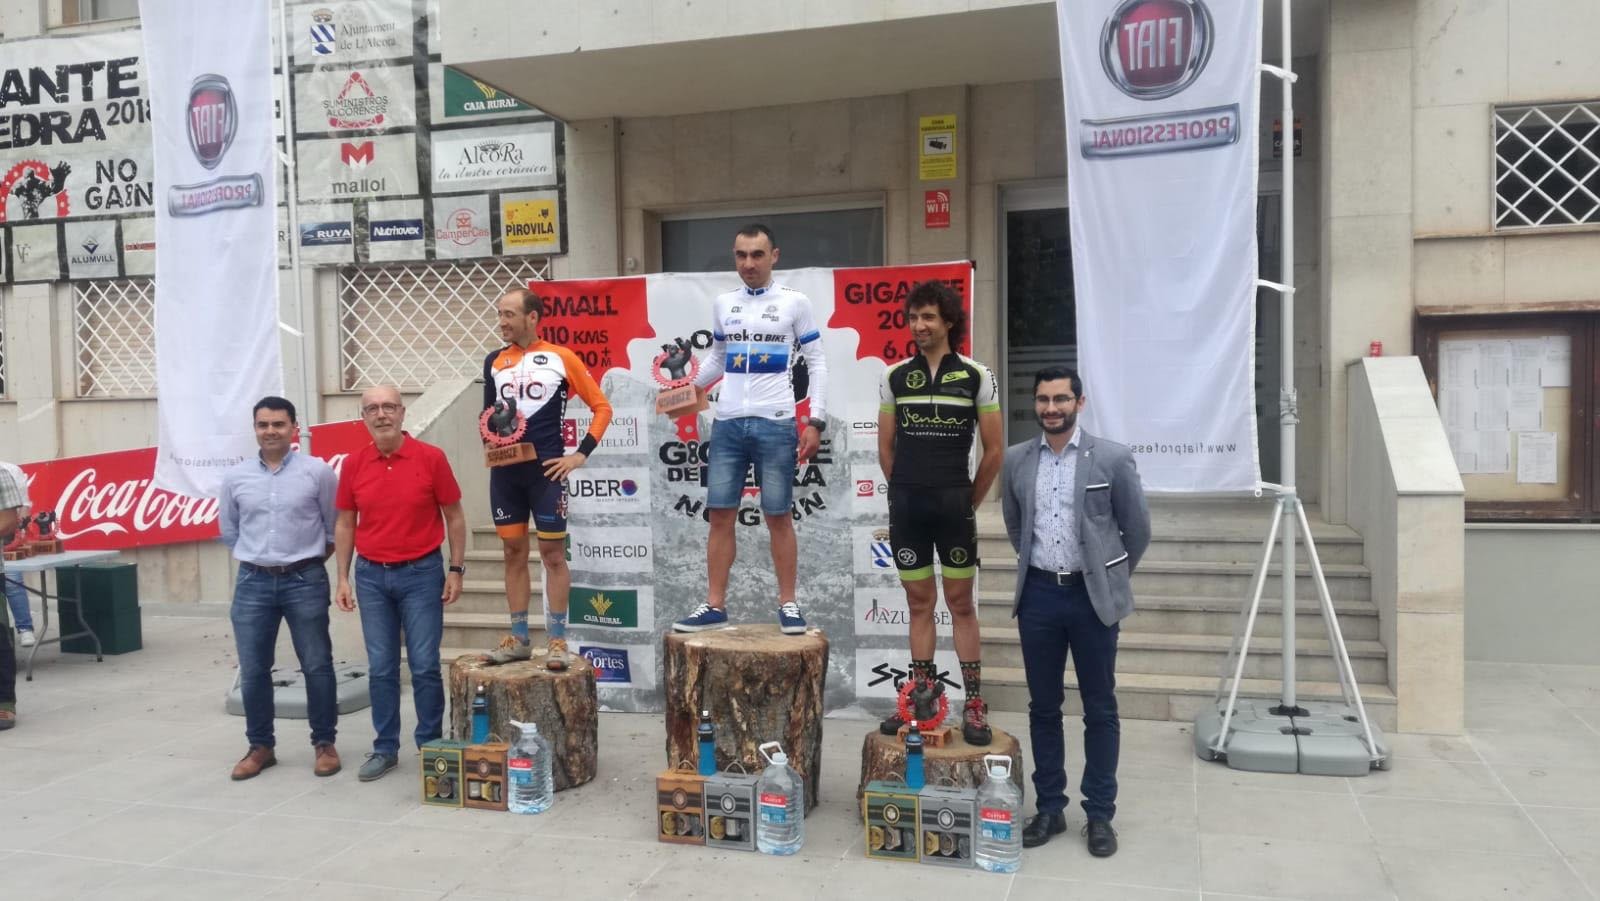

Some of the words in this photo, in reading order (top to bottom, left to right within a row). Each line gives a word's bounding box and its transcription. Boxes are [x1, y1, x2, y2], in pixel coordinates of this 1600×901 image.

[323, 96, 389, 109] SUMINISTROS
[464, 101, 487, 111] CAJA
[488, 98, 518, 109] RURAL
[326, 105, 387, 117] ALCORENSES
[96, 158, 138, 184] NO
[332, 178, 386, 194] mallol
[317, 228, 352, 239] RUYA
[505, 222, 555, 237] PIROVILA
[71, 255, 115, 265] ALUMVILL
[542, 295, 619, 317] SMALL
[573, 330, 609, 345] KMS
[577, 543, 648, 558] TORRECID
